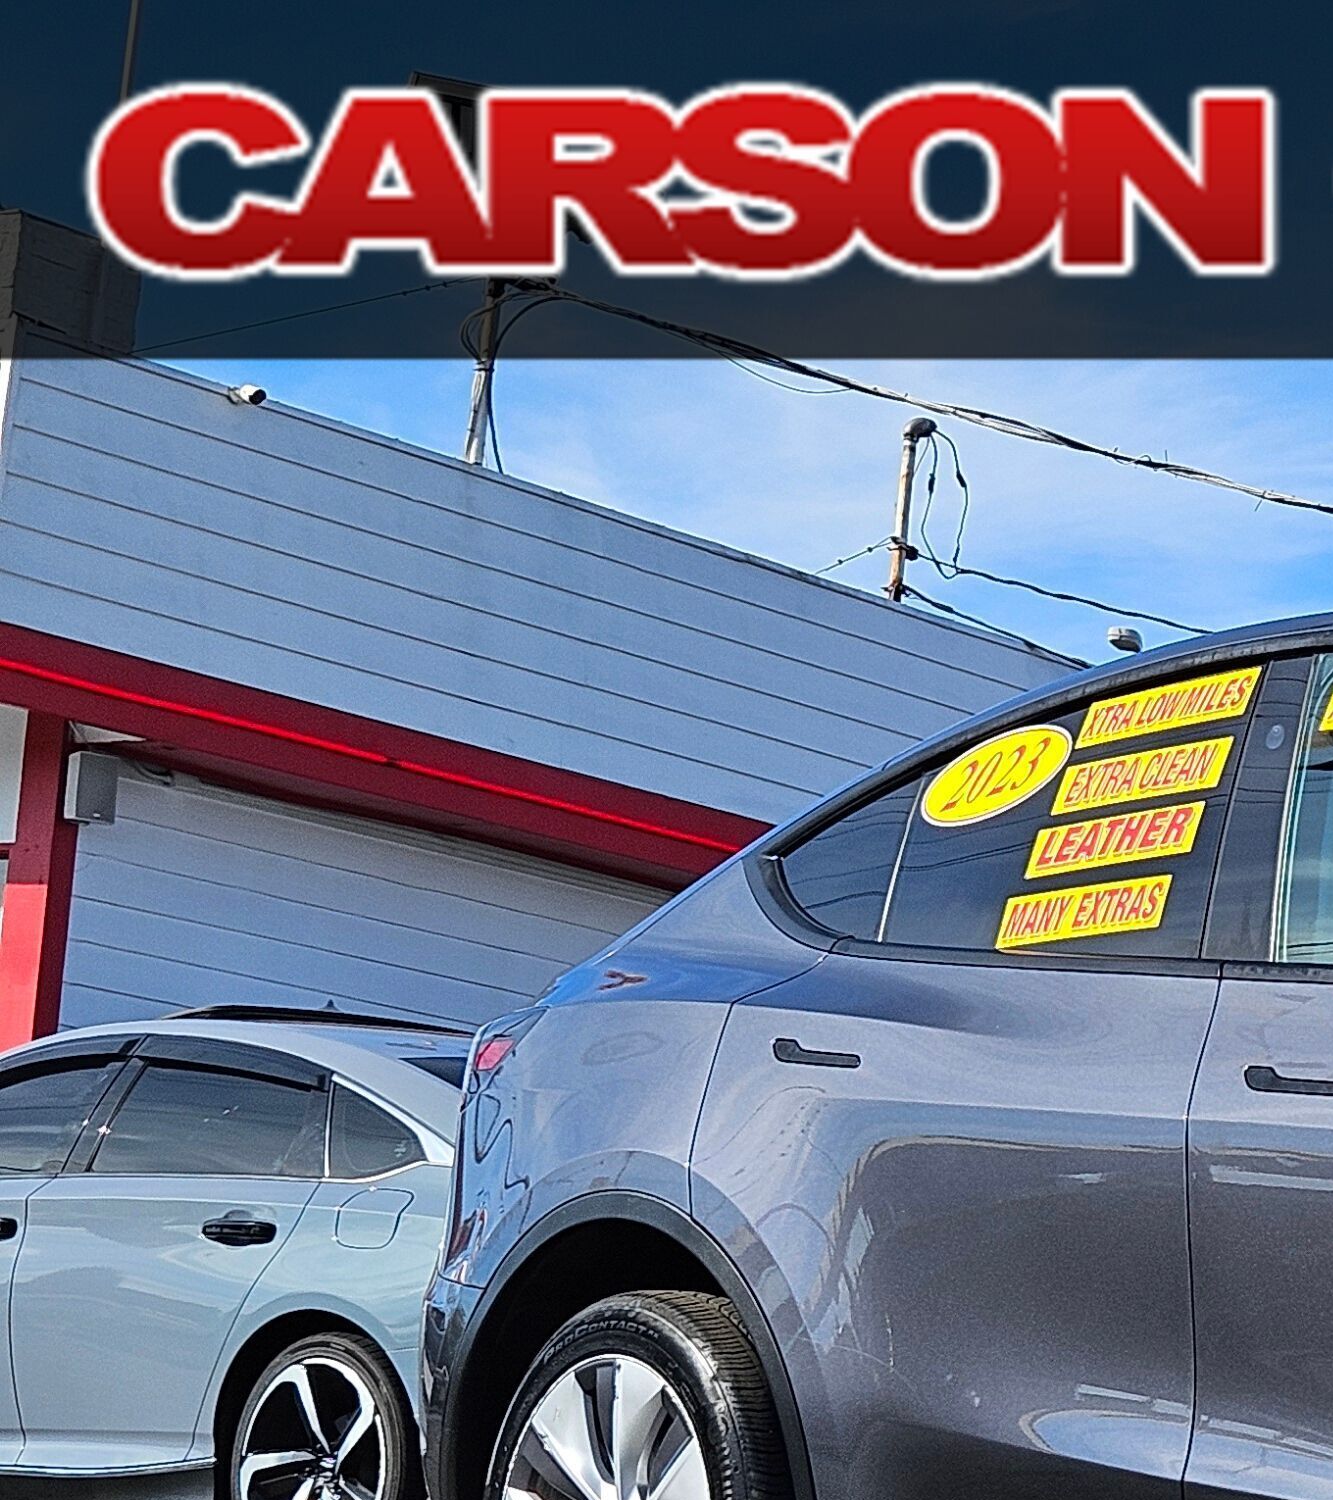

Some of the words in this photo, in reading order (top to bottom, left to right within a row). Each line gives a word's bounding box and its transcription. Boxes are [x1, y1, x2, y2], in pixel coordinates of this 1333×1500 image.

[1081, 699, 1139, 742] XTRA
[1134, 689, 1187, 728] LOW
[1178, 675, 1253, 719] MILES
[939, 736, 1052, 813] 2023
[1063, 756, 1141, 808] EXTRA
[1138, 743, 1219, 794] CLEAN
[1035, 806, 1197, 871] LEATHER
[1001, 894, 1075, 945] MANY
[1071, 881, 1165, 931] EXTRAS
